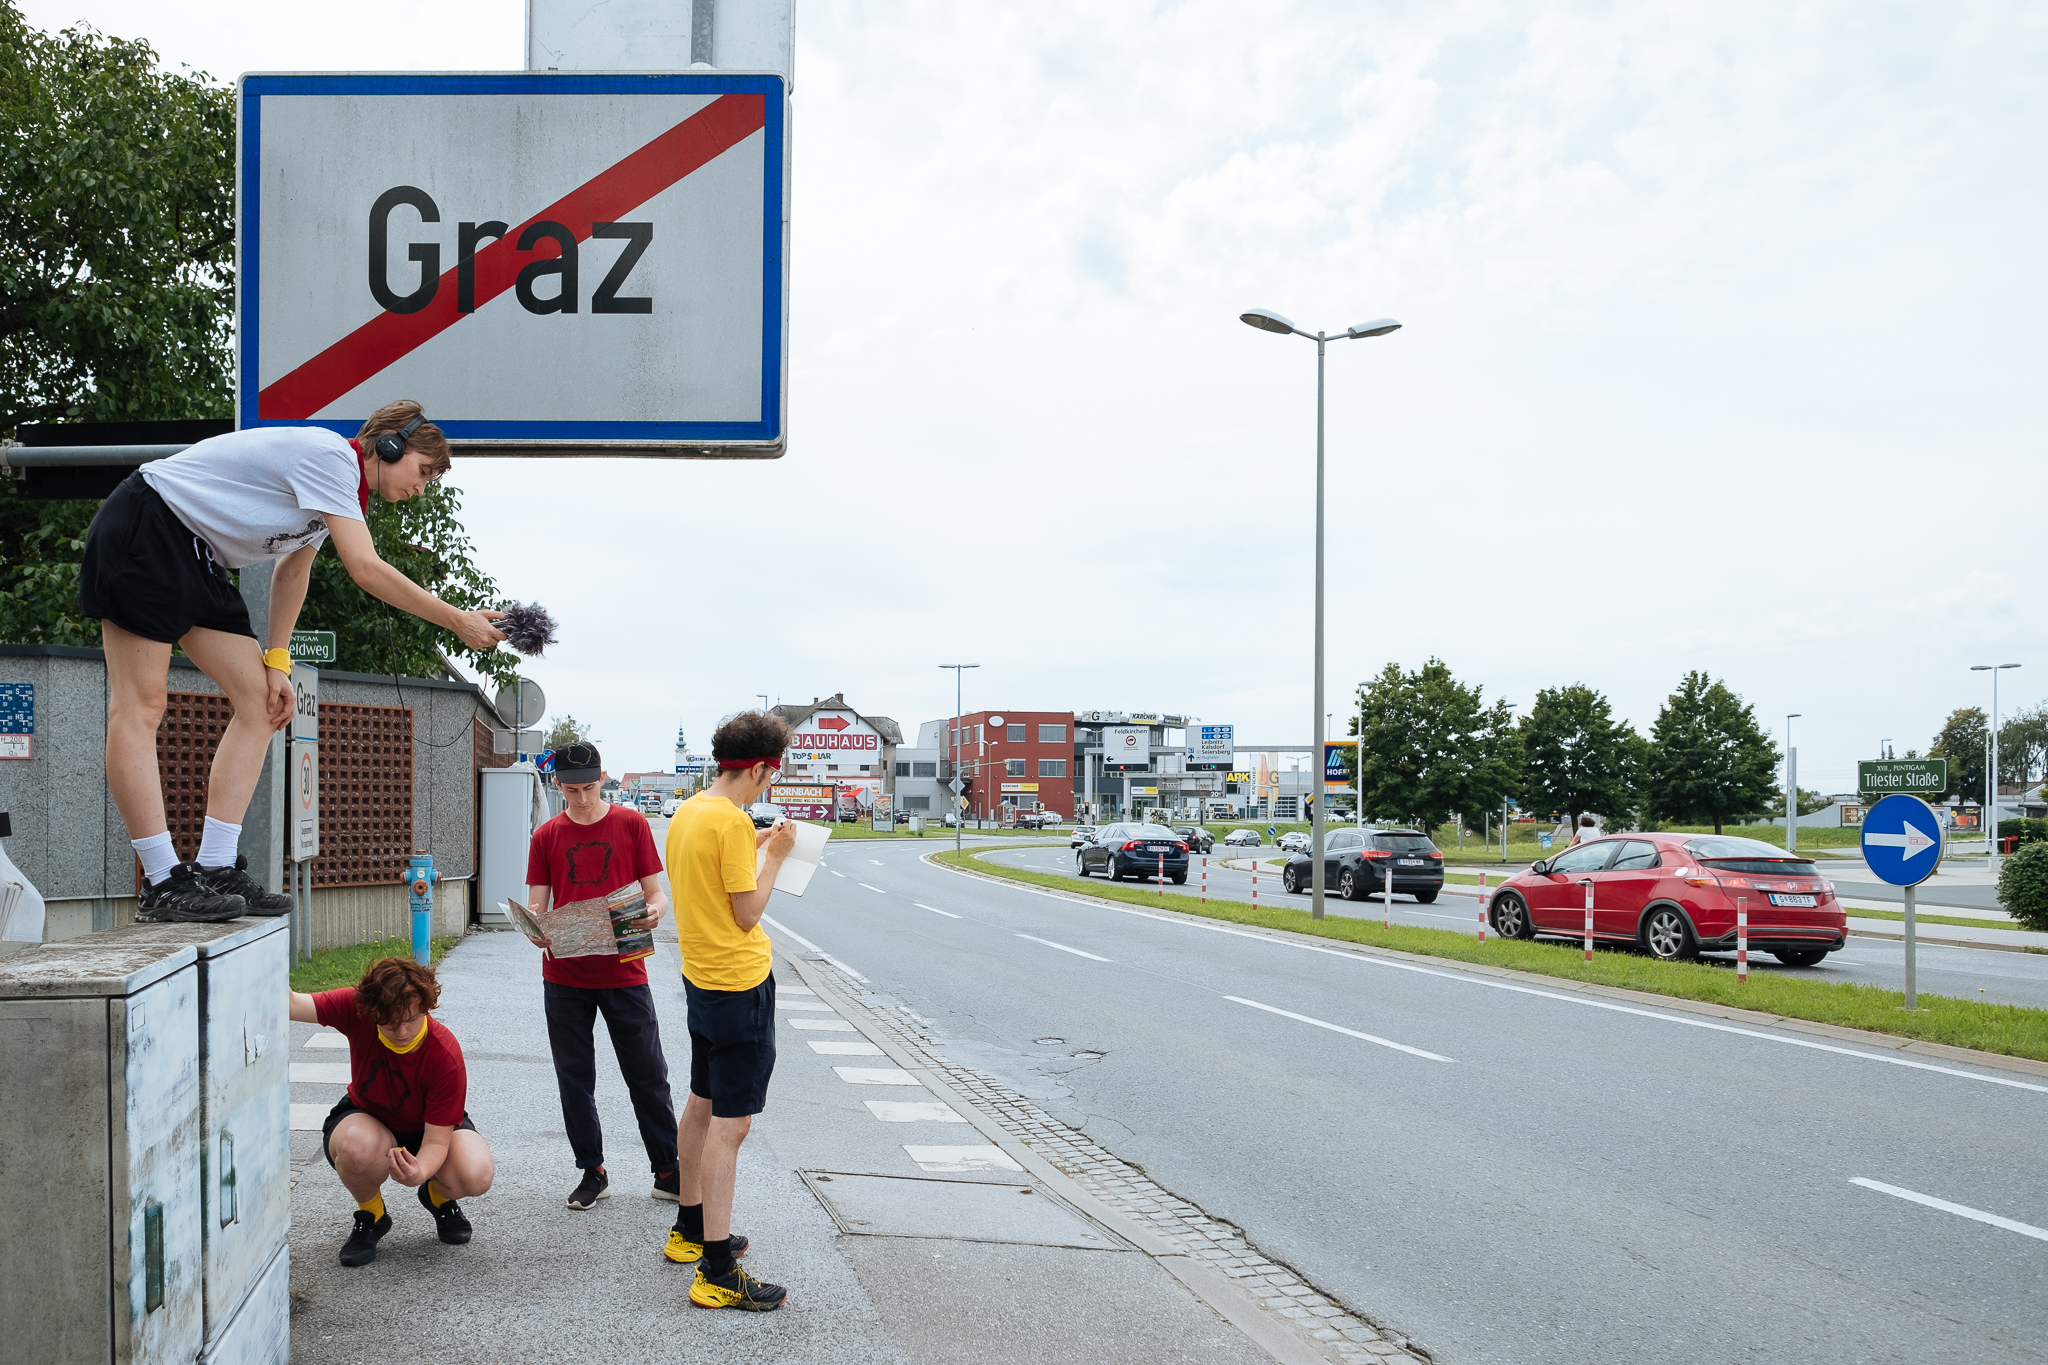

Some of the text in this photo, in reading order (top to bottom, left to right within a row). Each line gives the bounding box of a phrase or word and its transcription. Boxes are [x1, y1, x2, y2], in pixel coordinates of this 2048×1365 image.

[368, 185, 653, 315] Graz
[288, 642, 329, 659] eldweg
[296, 681, 316, 717] Graz
[791, 735, 876, 748] BAUHAUS
[792, 752, 806, 760] TOP
[303, 766, 310, 796] 30
[1864, 772, 1939, 787] Triester Straße
[771, 787, 822, 797] HORNBACH
